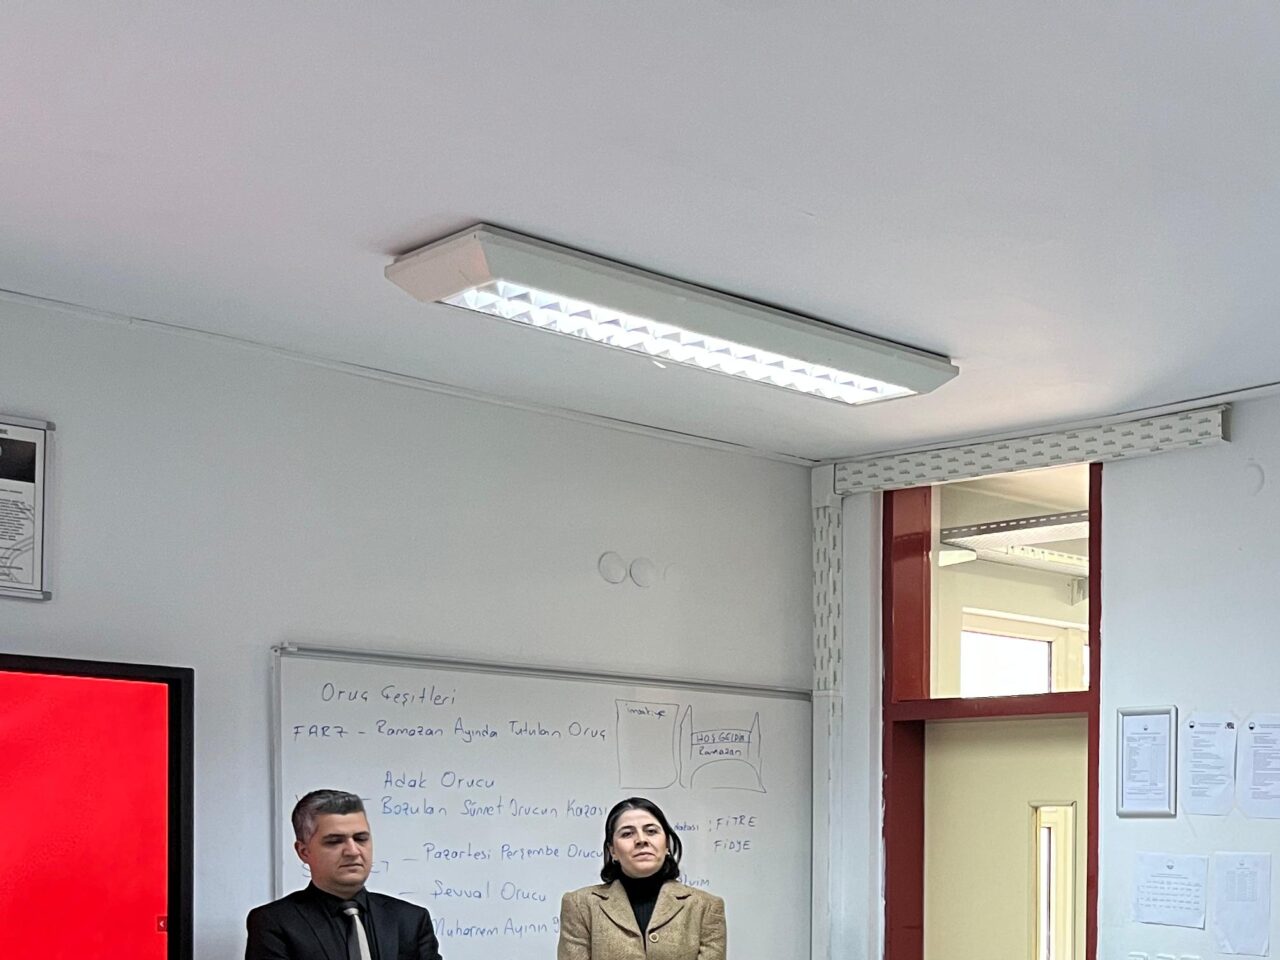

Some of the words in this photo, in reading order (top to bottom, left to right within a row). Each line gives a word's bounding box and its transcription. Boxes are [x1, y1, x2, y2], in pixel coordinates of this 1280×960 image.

[375, 719, 444, 738] Ramazan
[454, 716, 499, 743] Ayında
[568, 721, 607, 742] Oruç
[383, 770, 428, 790] Adak
[440, 771, 496, 788] Orucu
[381, 796, 448, 817] Bozulan
[423, 842, 491, 862] Pazartesi
[501, 843, 560, 861] Perşembe
[430, 880, 490, 900] Şevval
[501, 881, 546, 902] Orucu
